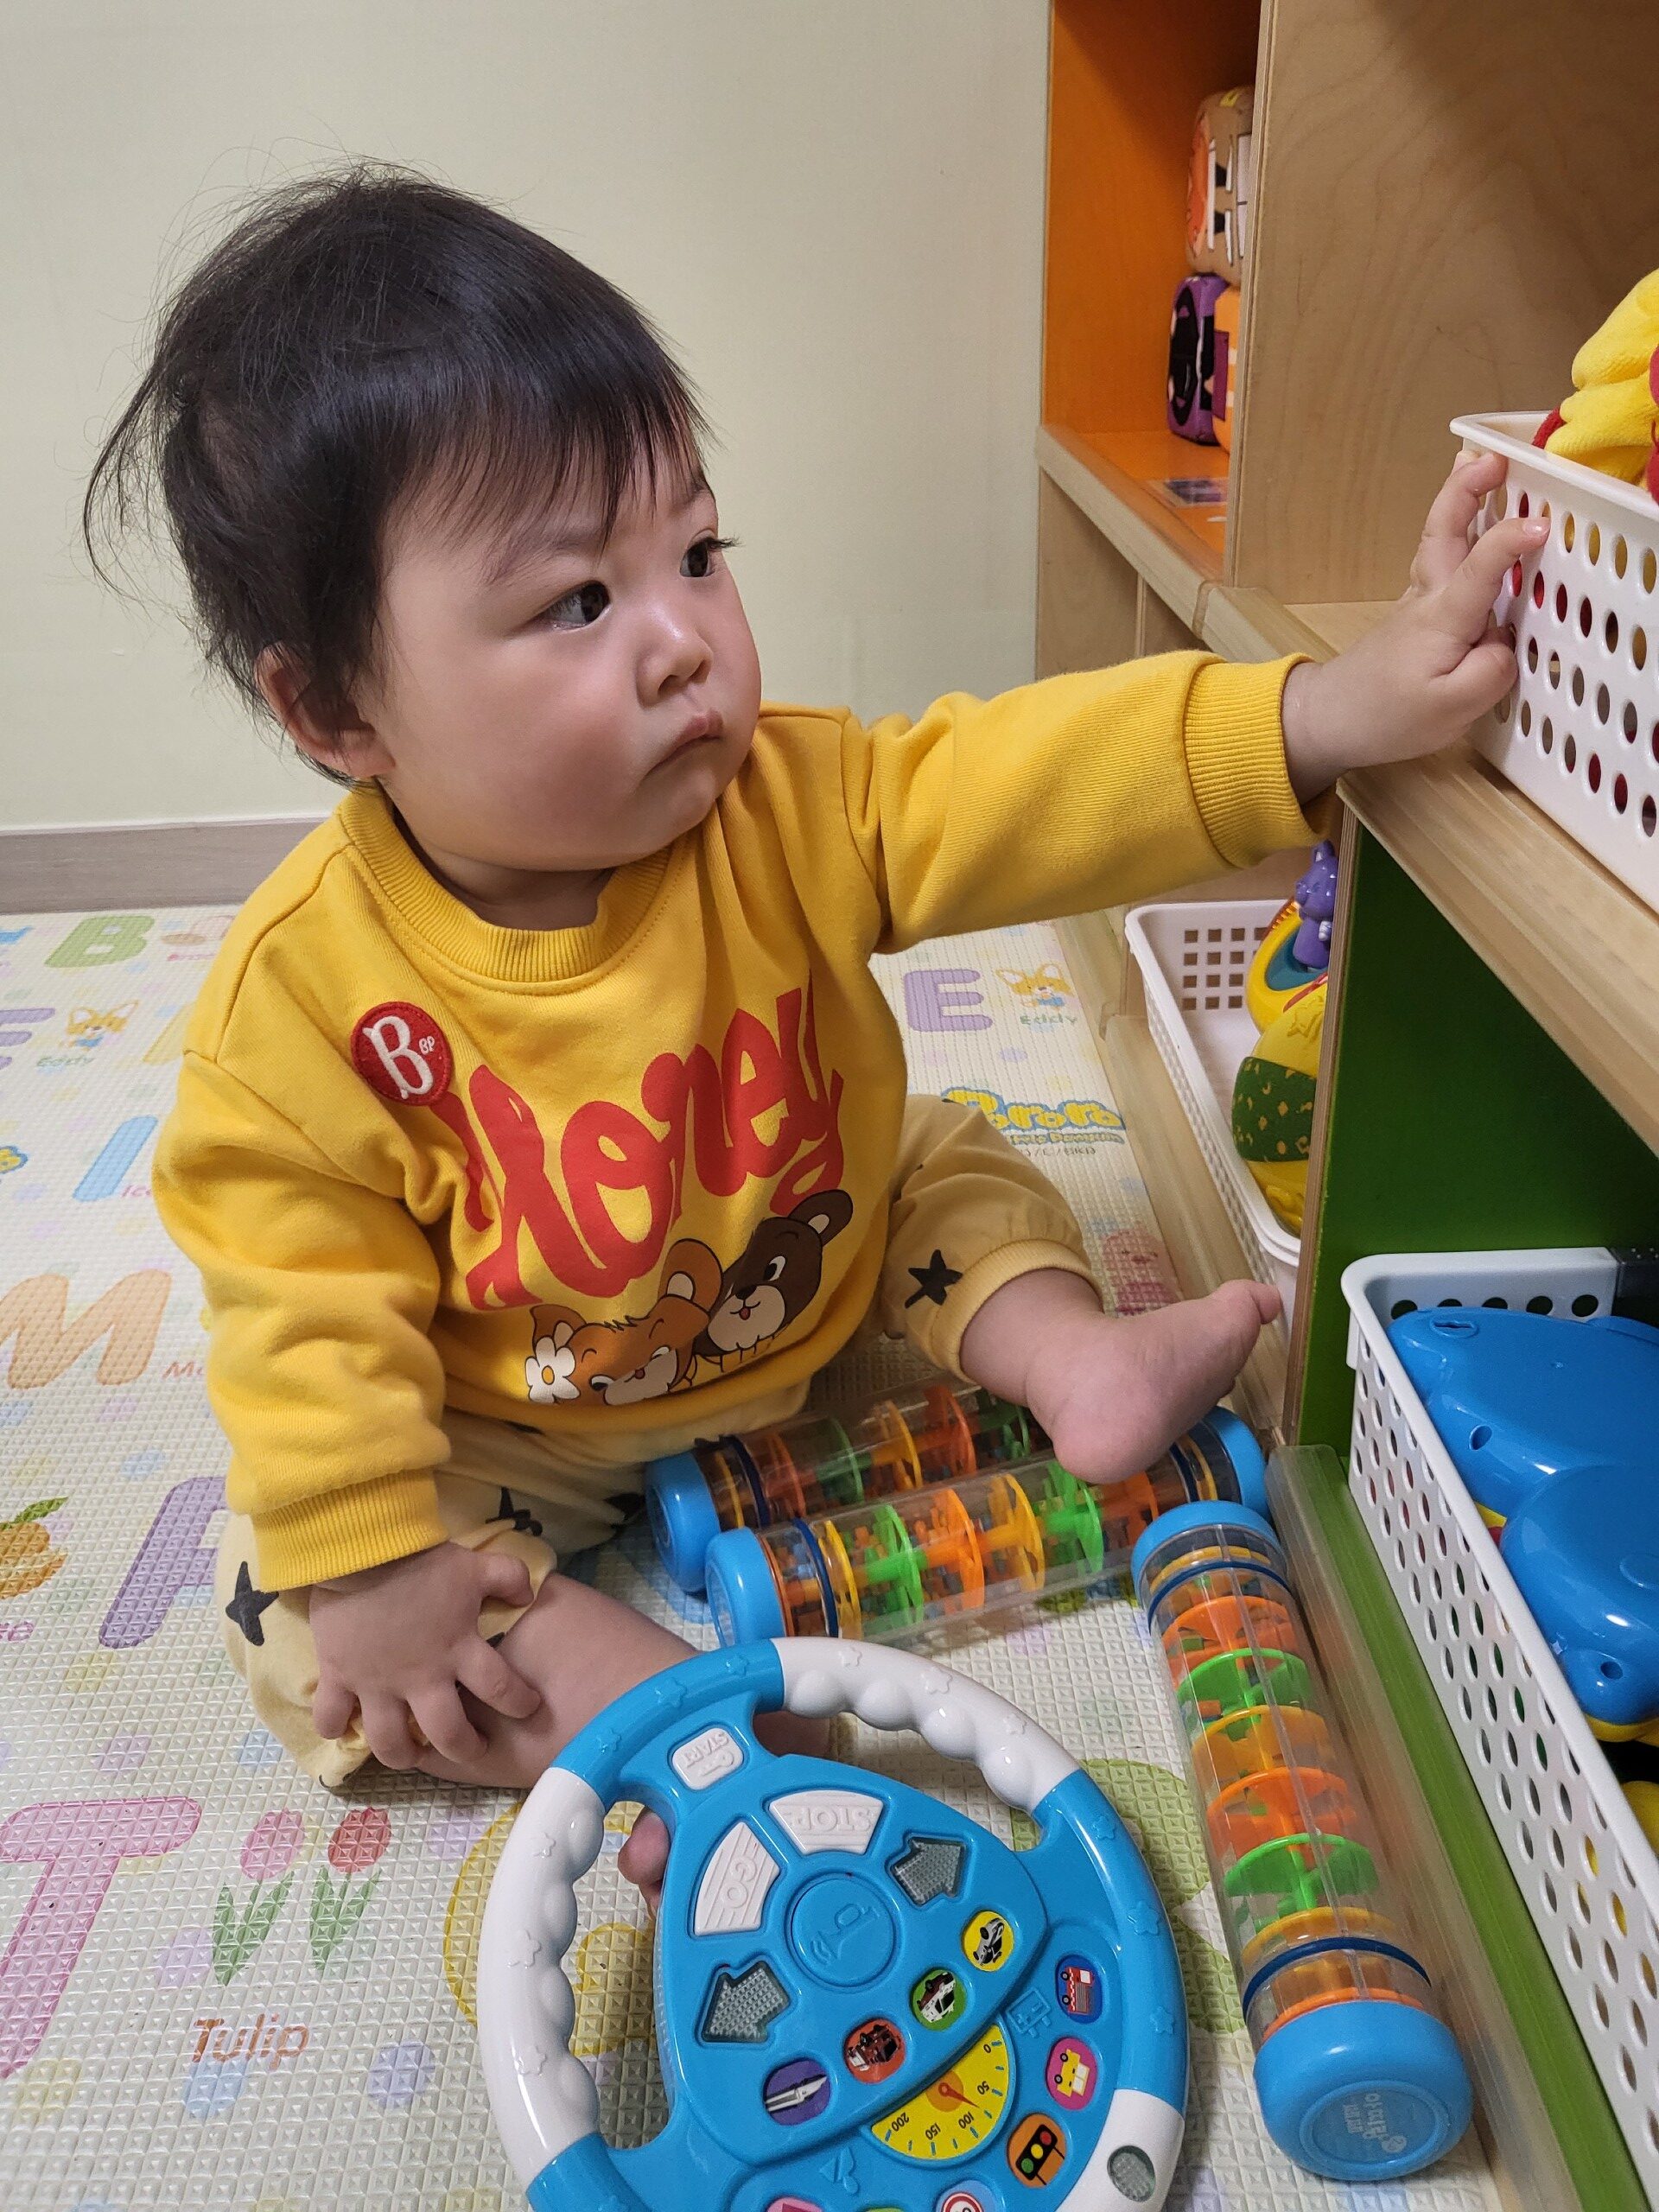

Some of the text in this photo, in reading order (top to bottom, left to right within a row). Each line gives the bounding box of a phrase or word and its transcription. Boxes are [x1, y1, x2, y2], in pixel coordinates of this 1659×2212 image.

[44, 915, 156, 968] B
[904, 969, 993, 1033] E
[1020, 1012, 1077, 1027] Eddy
[362, 1015, 434, 1099] B
[0, 1269, 172, 1390] M
[683, 1731, 730, 1768] START
[787, 1806, 874, 1833] STOP
[721, 1858, 760, 1909] GO
[0, 1796, 203, 2079] T
[192, 2012, 309, 2072] Tulip
[983, 2044, 992, 2054] 0
[977, 2081, 990, 2095] 50
[892, 2112, 910, 2132] 200
[925, 2122, 942, 2140] 150
[958, 2111, 975, 2129] 100
